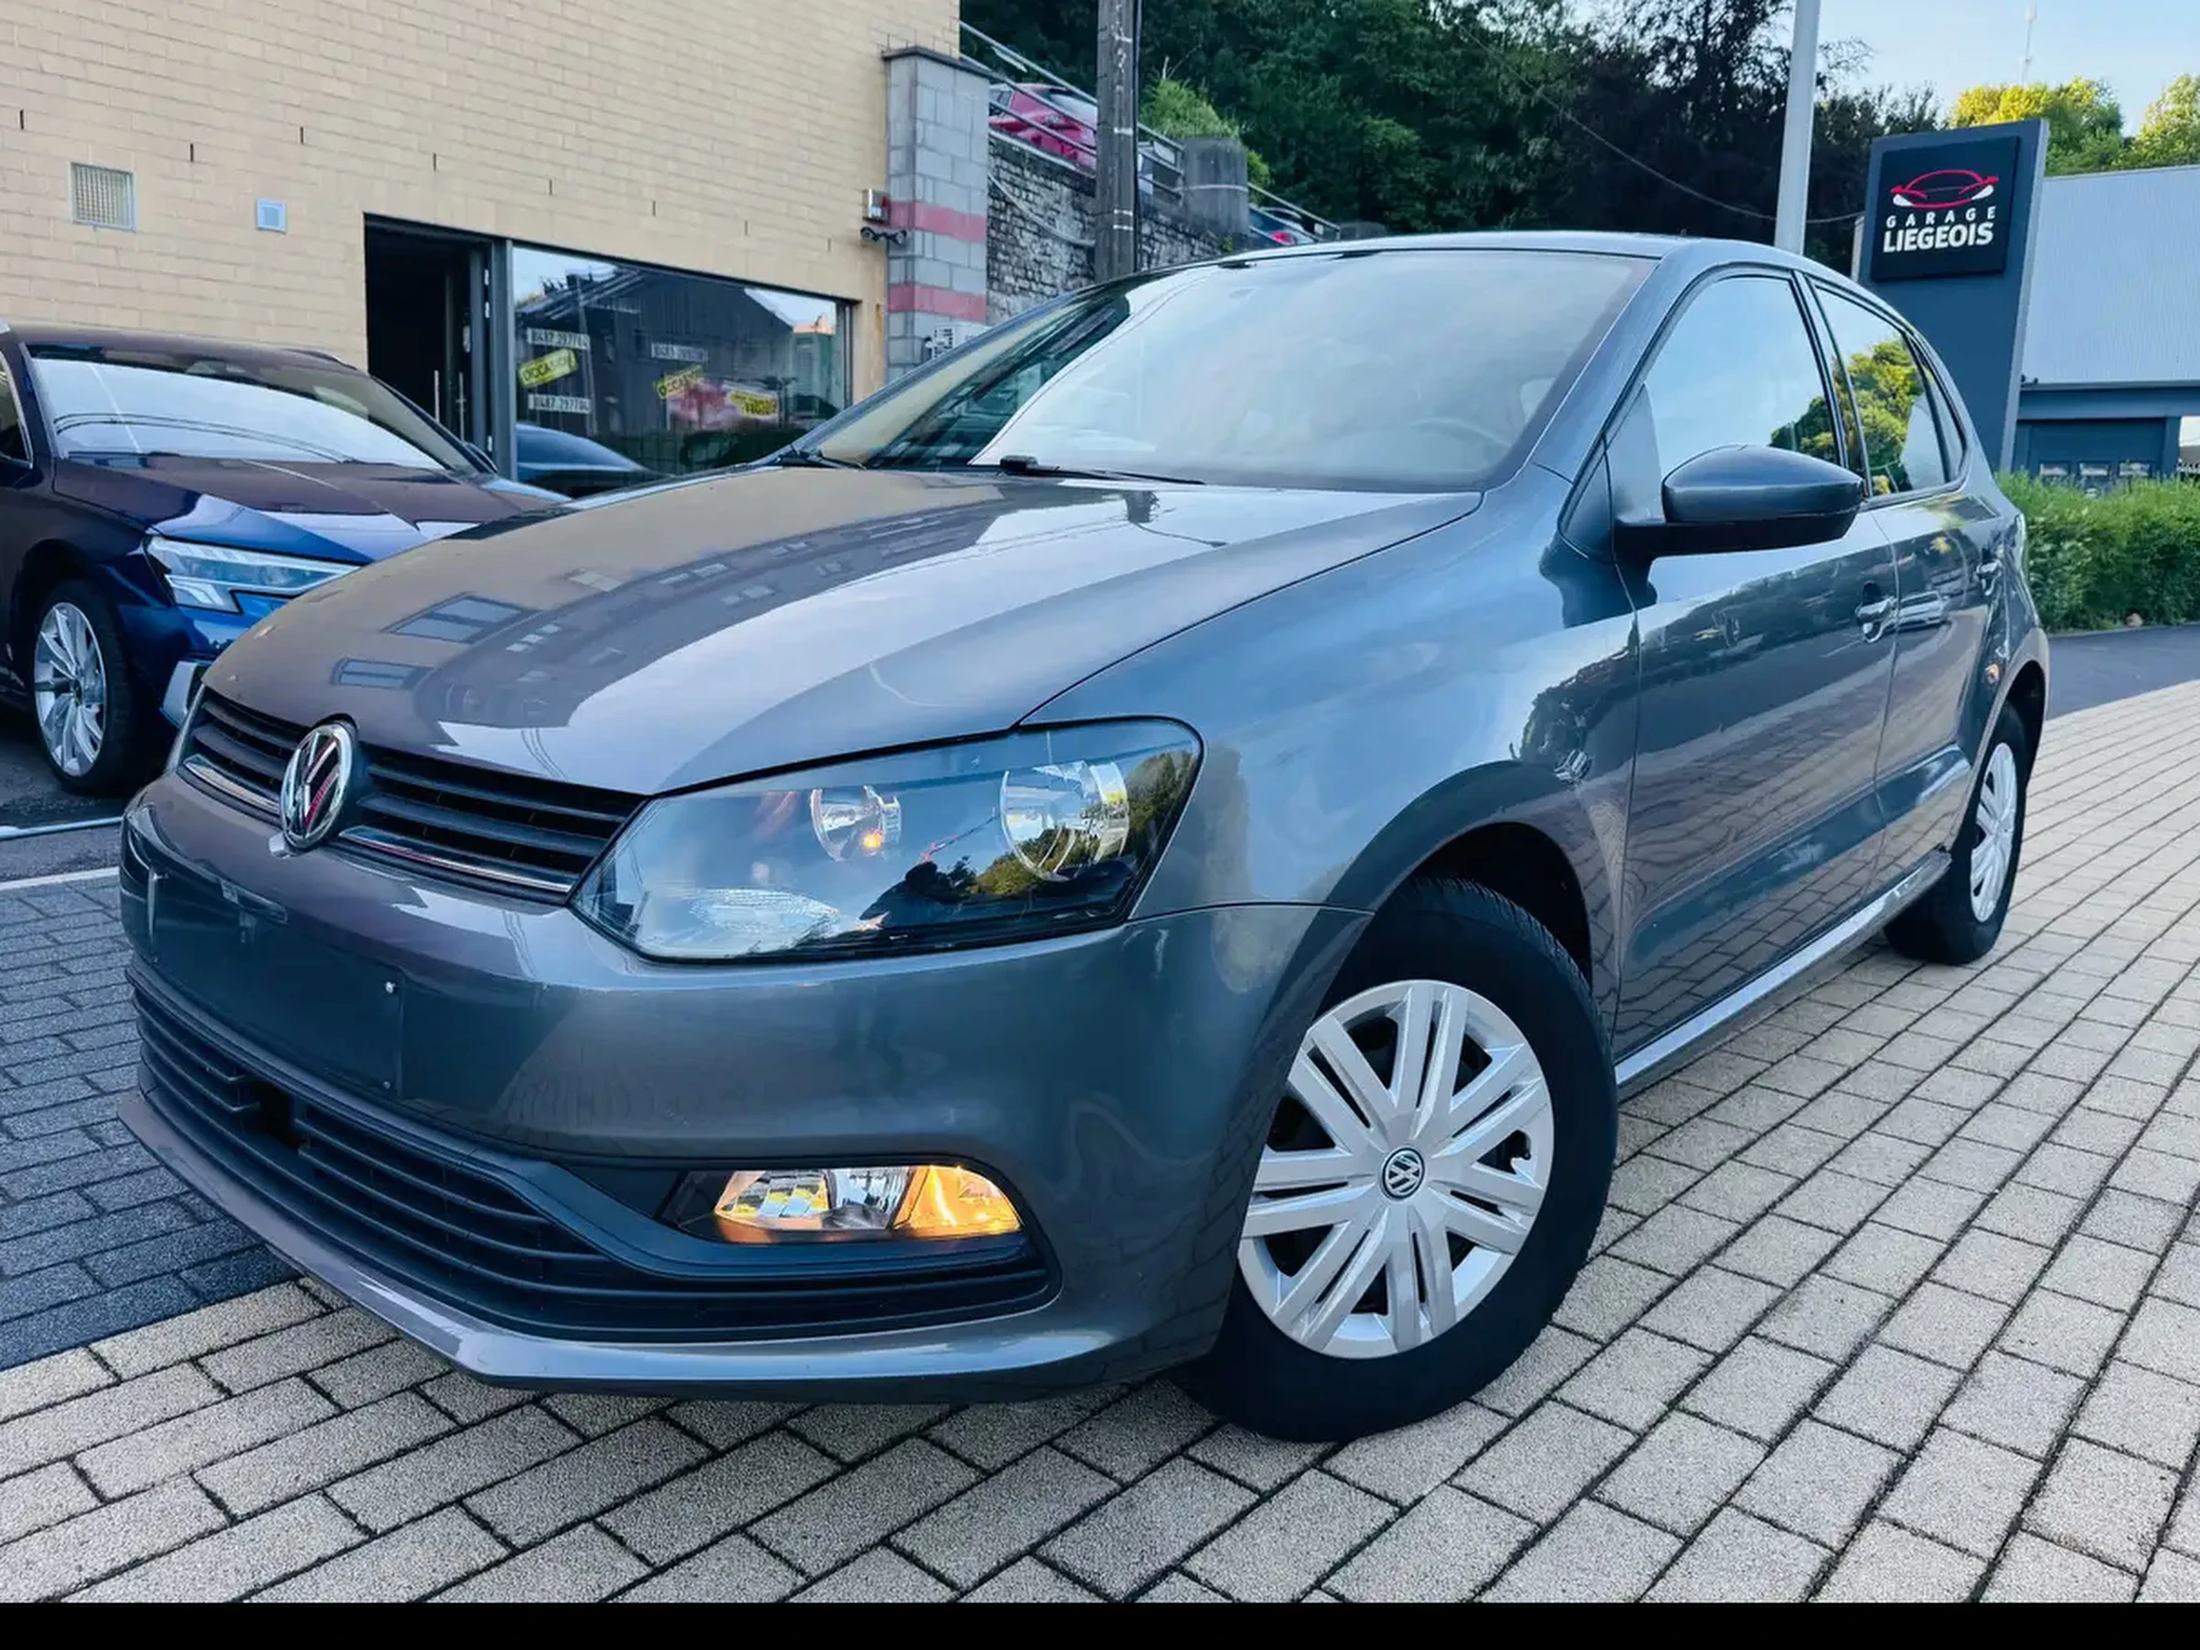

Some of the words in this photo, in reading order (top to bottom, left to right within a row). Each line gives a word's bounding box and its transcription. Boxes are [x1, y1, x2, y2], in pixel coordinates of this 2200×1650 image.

[1886, 206, 1996, 229] GARAGE
[1882, 222, 1994, 253] LIEGEOIS
[1382, 1147, 1425, 1199] VW
